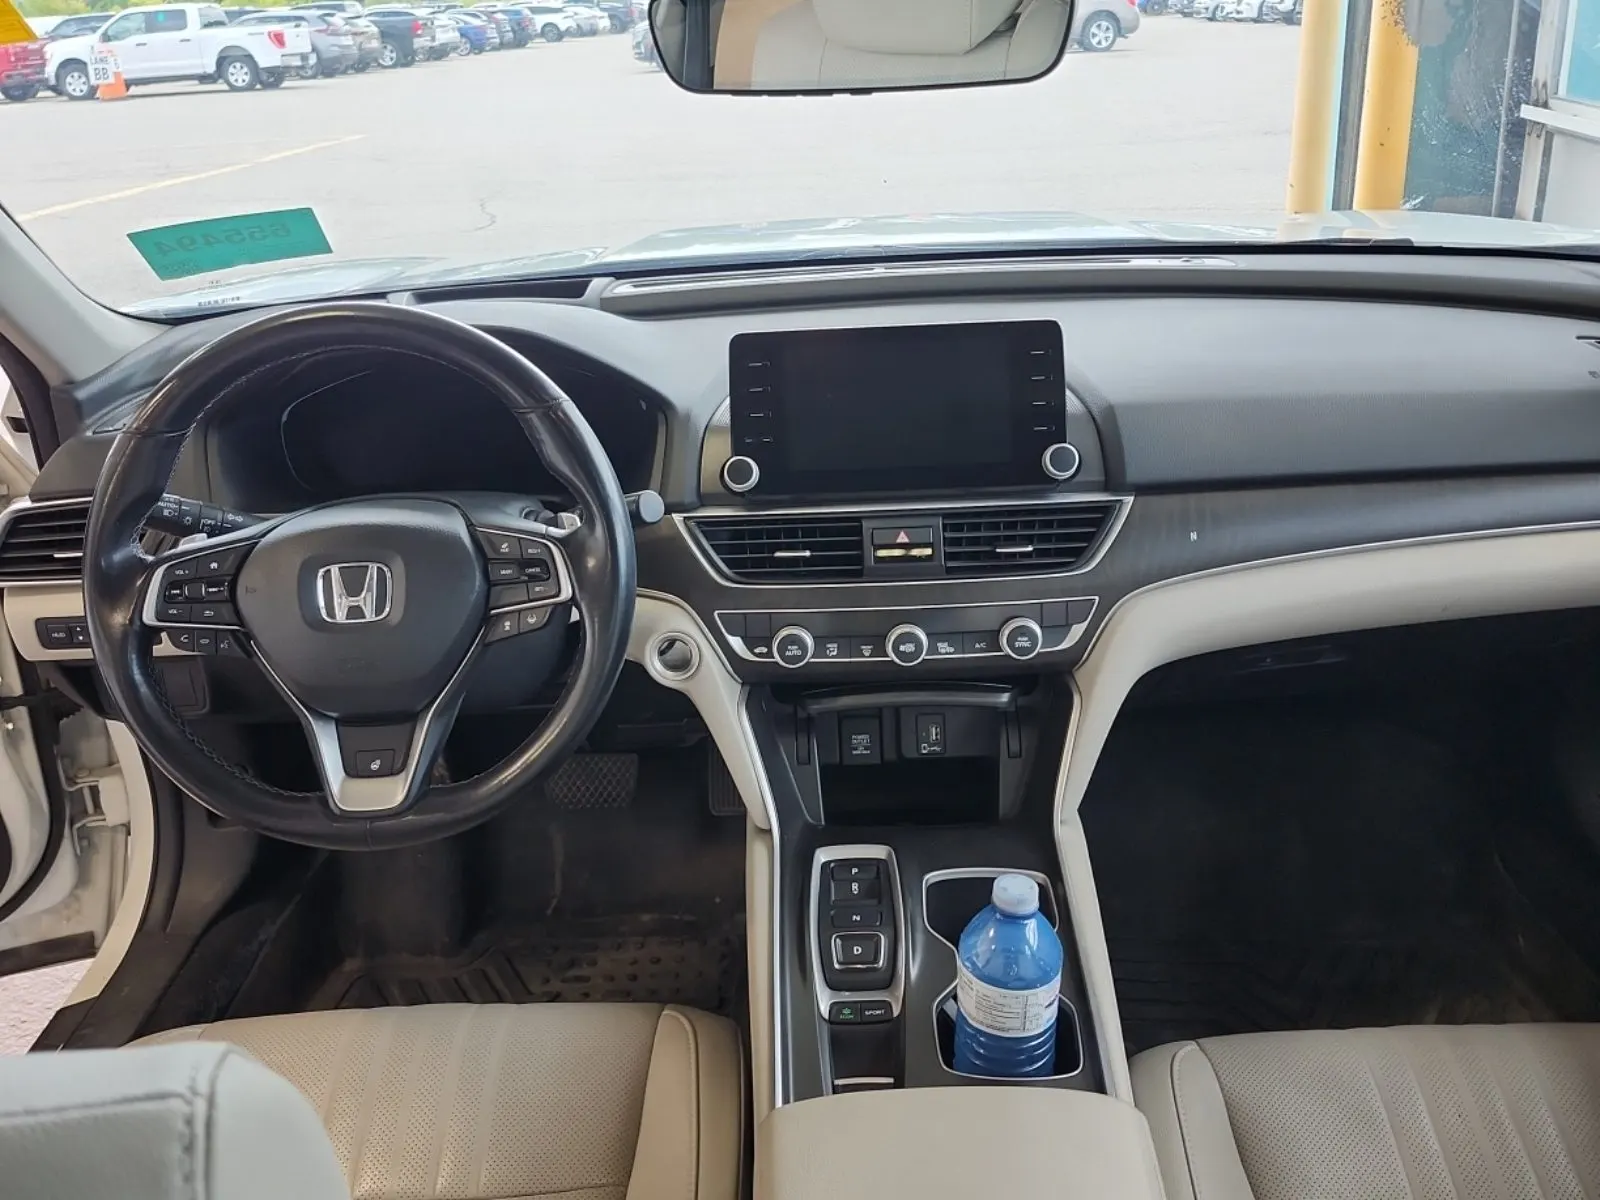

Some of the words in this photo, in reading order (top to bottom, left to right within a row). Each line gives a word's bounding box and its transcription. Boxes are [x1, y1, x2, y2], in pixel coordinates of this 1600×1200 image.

[94, 67, 110, 81] BB
[851, 867, 859, 876] P
[851, 882, 859, 891] R
[852, 914, 861, 922] N
[853, 945, 862, 955] D
